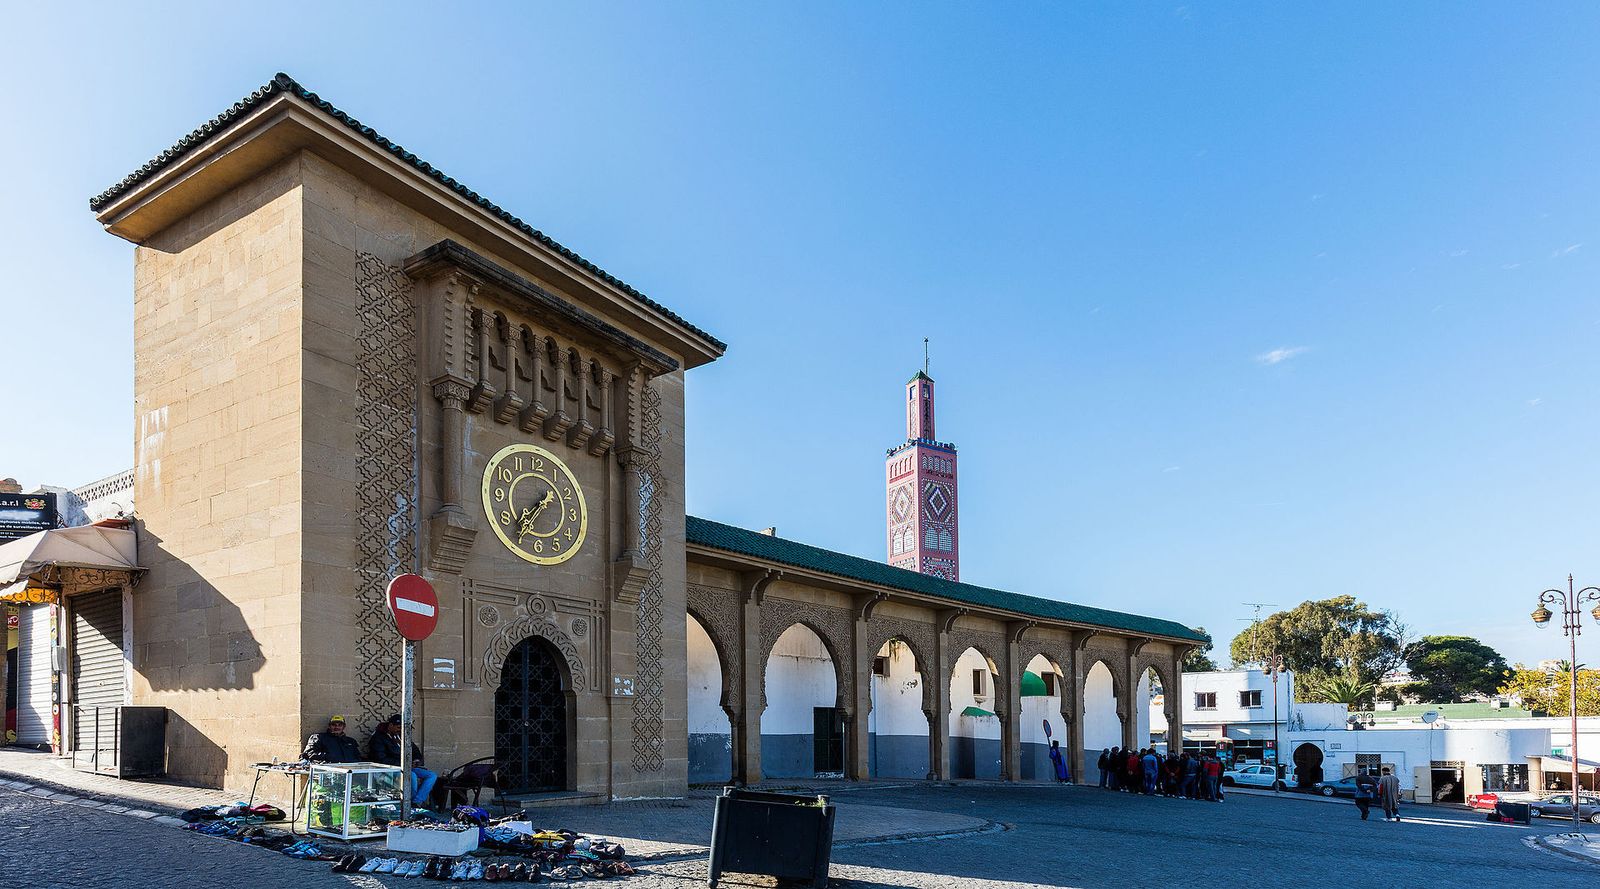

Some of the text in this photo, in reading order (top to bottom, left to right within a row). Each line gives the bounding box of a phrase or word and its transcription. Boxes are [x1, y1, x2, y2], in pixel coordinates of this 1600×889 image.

[515, 457, 522, 472] 11
[531, 457, 544, 472] 12
[497, 466, 512, 483] 10
[553, 468, 557, 482] 1
[494, 488, 505, 502] 9
[563, 487, 572, 500] 2
[500, 510, 511, 526] 8
[568, 508, 577, 522] 3
[563, 527, 572, 541] 4
[533, 539, 543, 553] 6
[551, 537, 560, 552] 5
